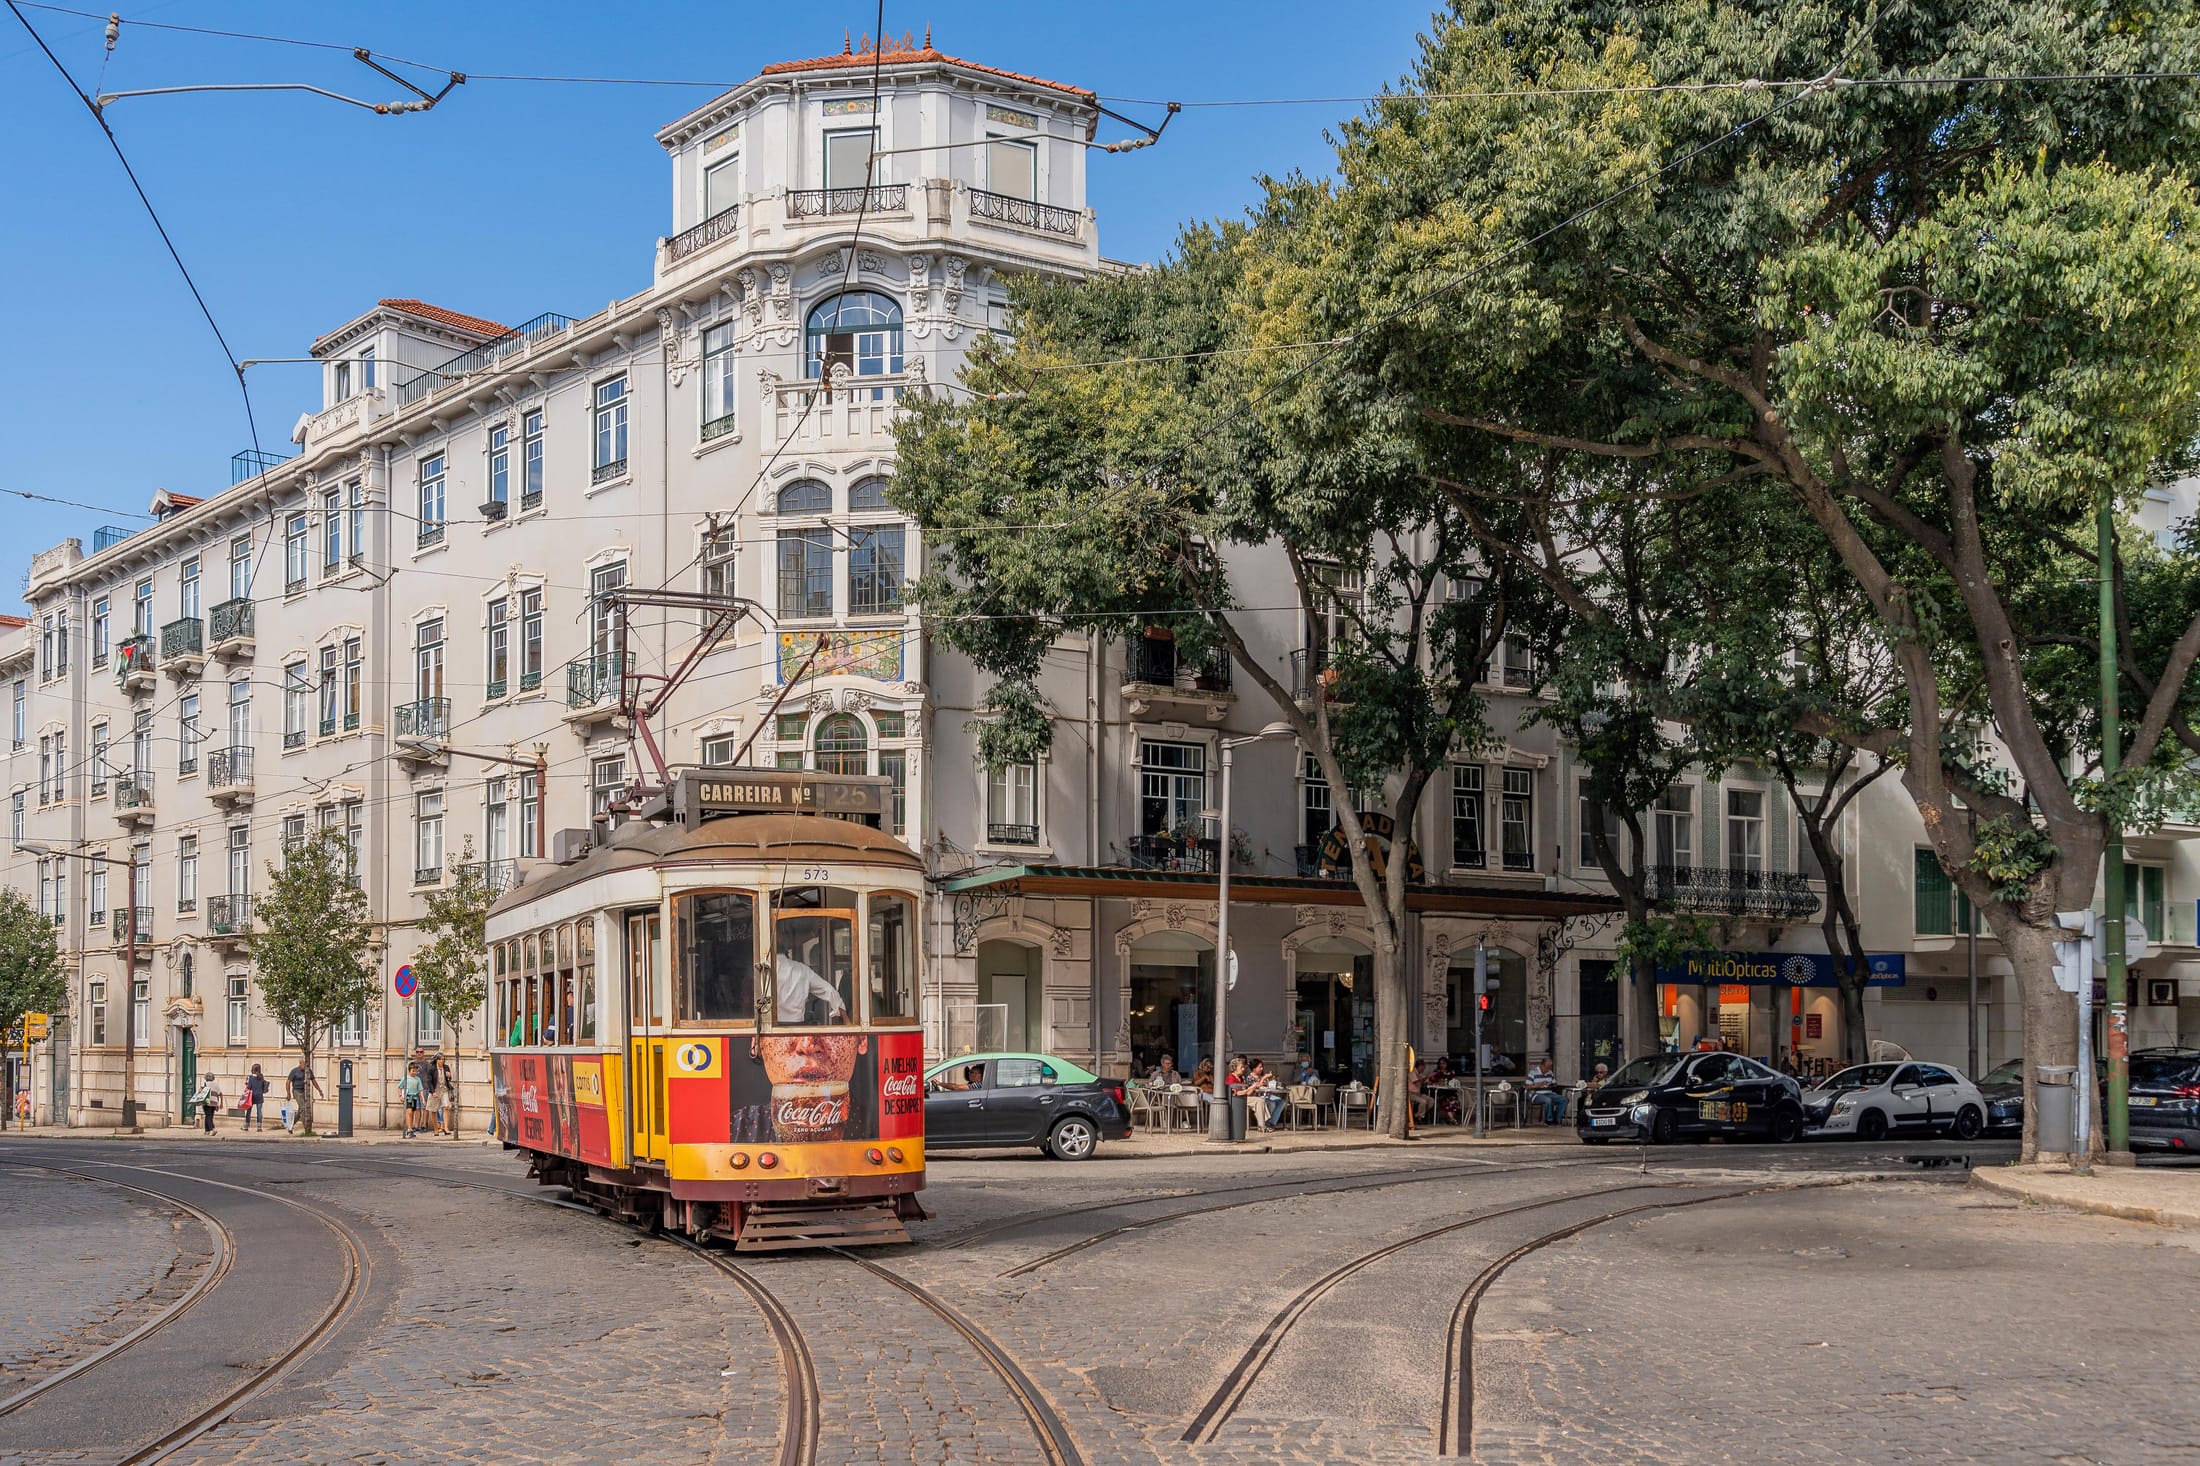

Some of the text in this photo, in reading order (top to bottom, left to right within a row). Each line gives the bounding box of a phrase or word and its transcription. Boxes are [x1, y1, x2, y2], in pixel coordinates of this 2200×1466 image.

[700, 783, 782, 804] CARREIRA
[833, 785, 867, 806] 25
[803, 869, 829, 881] 573
[884, 1057, 917, 1074] A MELHOR
[885, 1099, 895, 1116] DE
